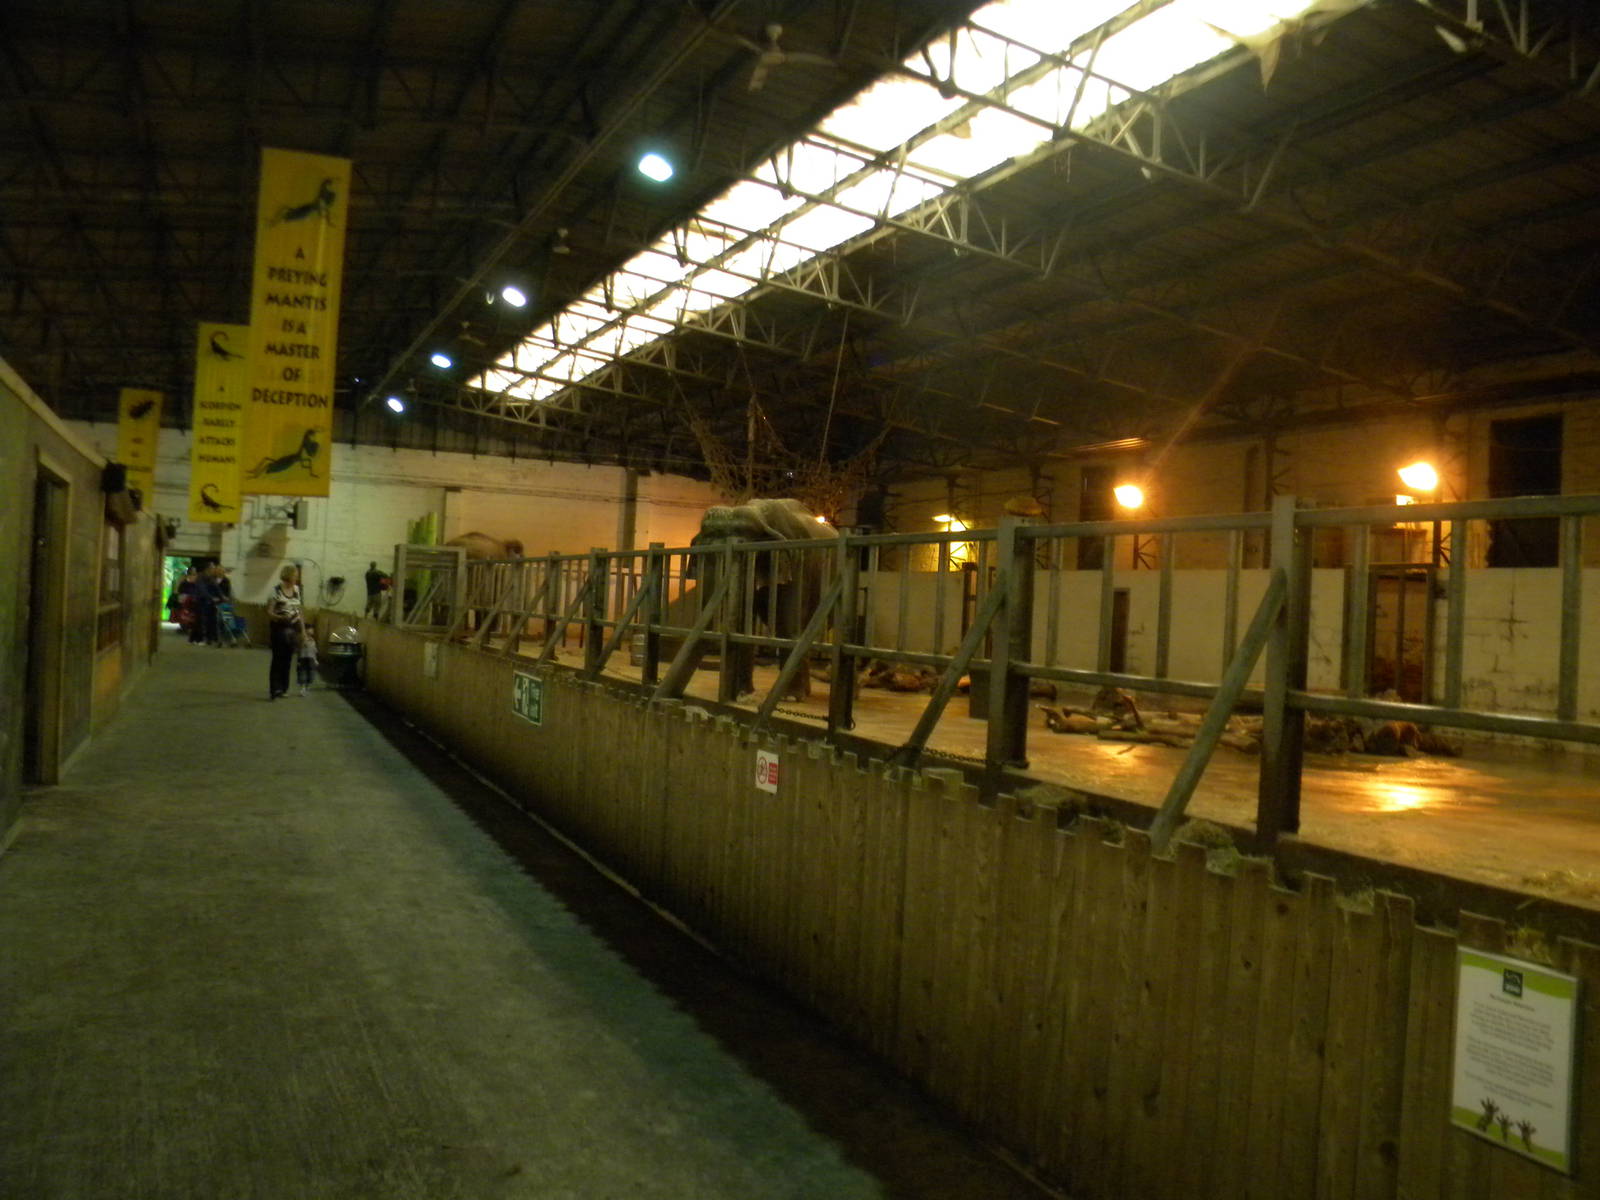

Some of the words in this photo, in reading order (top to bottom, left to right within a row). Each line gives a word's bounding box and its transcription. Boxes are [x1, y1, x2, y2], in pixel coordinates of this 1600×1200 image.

[295, 246, 305, 260] A
[265, 293, 327, 312] MANTIS
[281, 319, 295, 333] IS
[296, 321, 307, 335] A
[264, 342, 320, 359] MASTER
[282, 367, 302, 382] OF
[252, 387, 329, 409] DECEPTION
